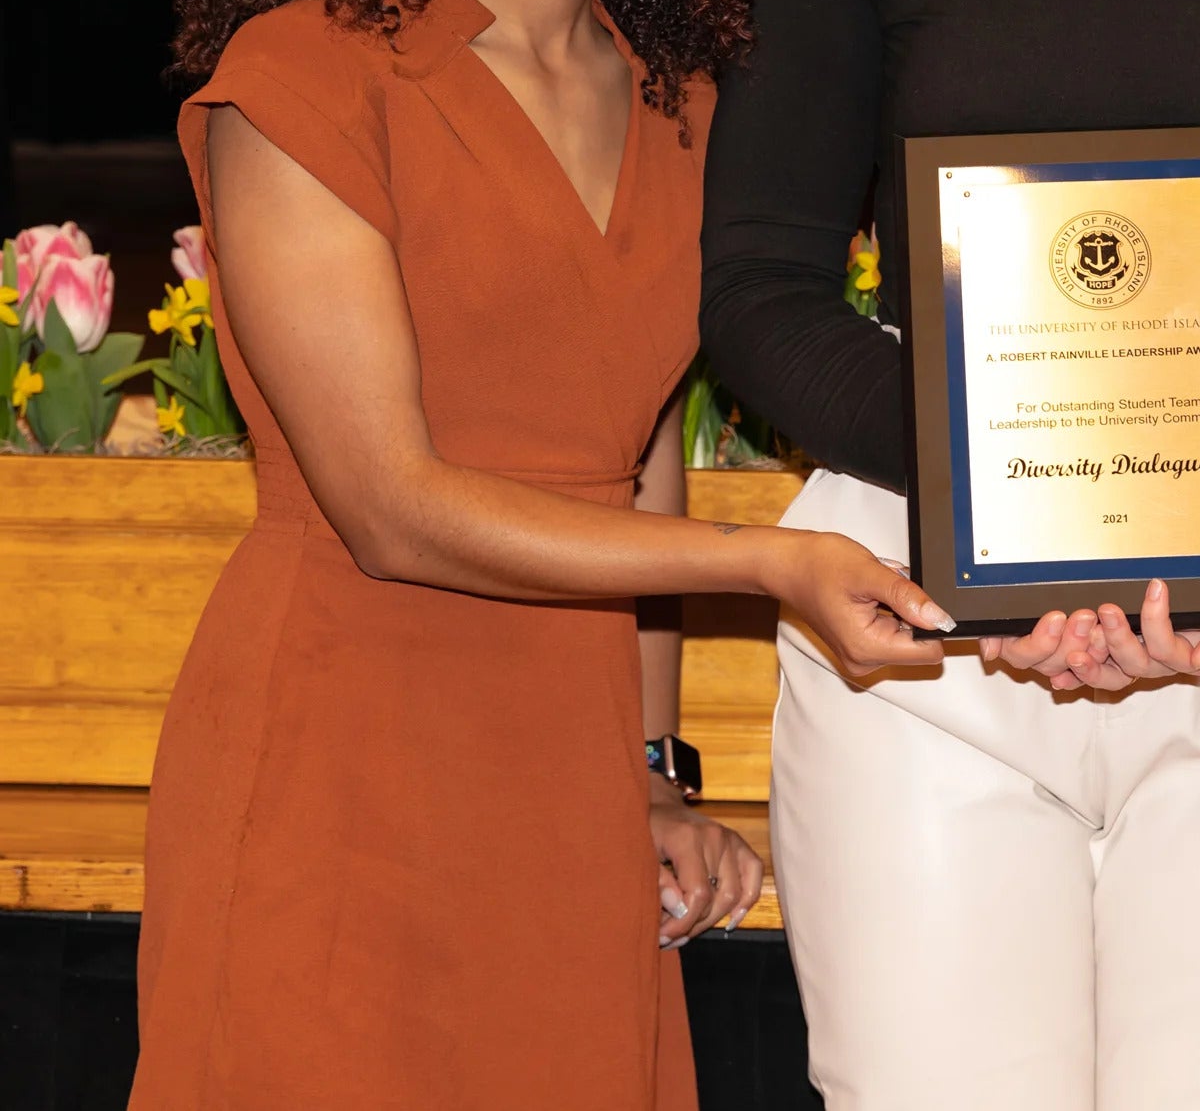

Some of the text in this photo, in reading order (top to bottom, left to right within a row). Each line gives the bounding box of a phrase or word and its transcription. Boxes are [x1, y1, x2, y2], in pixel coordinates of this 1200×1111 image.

[1055, 217, 1146, 293] UNIVERSITY OF RHODE ISLAND
[1089, 280, 1113, 289] HOPE
[1091, 296, 1114, 304] 1892
[988, 324, 1013, 335] THE
[1018, 322, 1097, 334] UNIVERSITY
[1100, 321, 1117, 331] OF
[1122, 319, 1169, 330] RHODE
[986, 353, 997, 363] A.
[1000, 351, 1047, 362] ROBERT
[1050, 349, 1109, 360] RAINVILLE
[1112, 346, 1183, 358] LEADERSHIP
[1016, 402, 1037, 413] For
[1041, 400, 1115, 413] Outstanding
[1118, 398, 1166, 410] Student
[989, 417, 1057, 430] Leadership
[1060, 417, 1073, 427] to
[1076, 416, 1095, 427] the
[1098, 414, 1159, 427] University
[1007, 457, 1104, 483] Diversity
[1102, 514, 1129, 524] 2021
